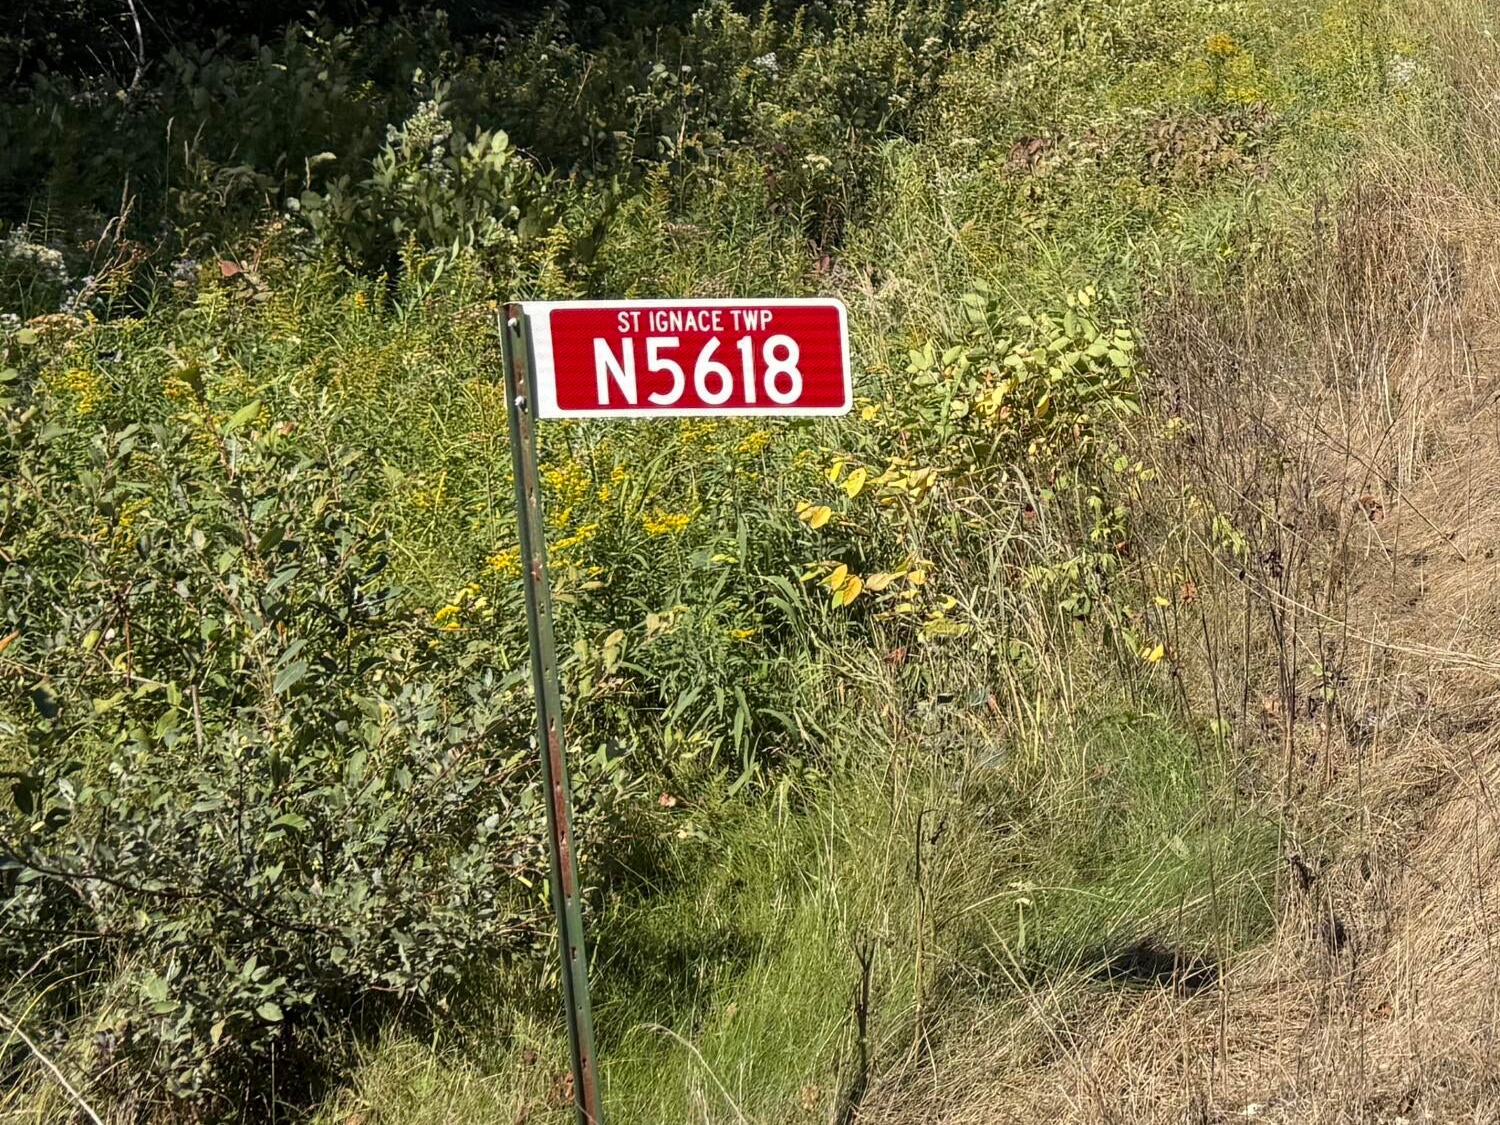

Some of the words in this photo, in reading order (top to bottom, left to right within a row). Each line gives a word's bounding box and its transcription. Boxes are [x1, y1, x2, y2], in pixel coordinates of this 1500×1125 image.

[617, 311, 641, 332] ST
[650, 310, 724, 332] IGNACE
[730, 310, 773, 331] TWP
[593, 334, 802, 405] N5618
